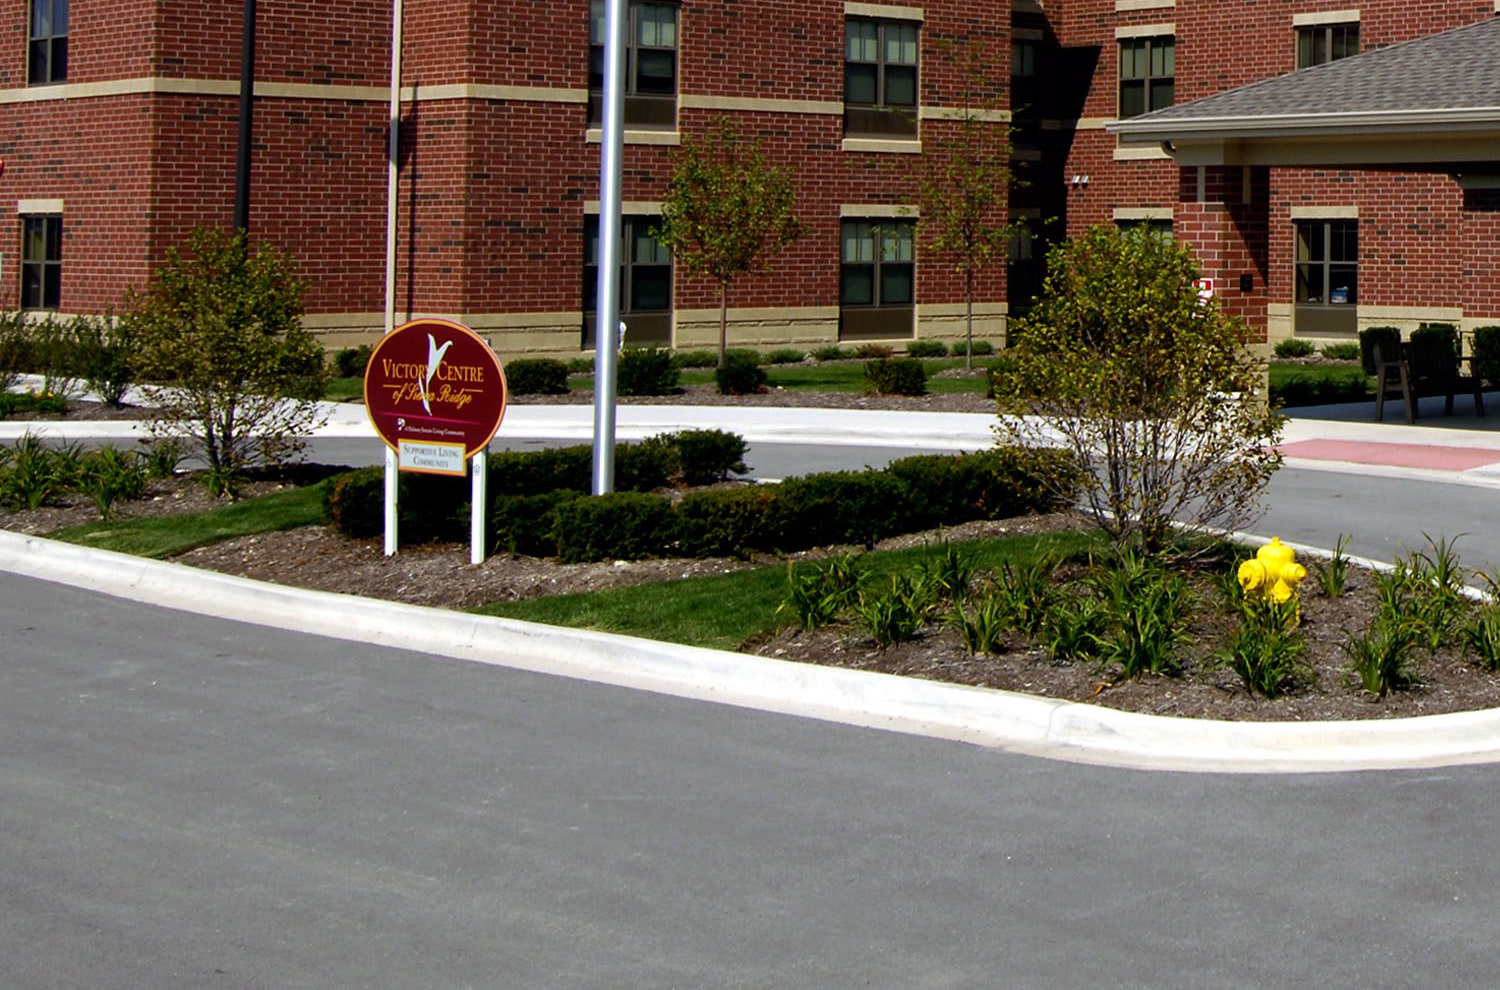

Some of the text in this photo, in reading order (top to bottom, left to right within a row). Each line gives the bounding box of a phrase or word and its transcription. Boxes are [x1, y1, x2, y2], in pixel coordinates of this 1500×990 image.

[382, 358, 484, 383] VICTORY CENTRE
[392, 382, 409, 405] of
[436, 383, 472, 410] Ridge
[438, 447, 460, 458] LIVING
[413, 456, 449, 468] COMMUNITY
